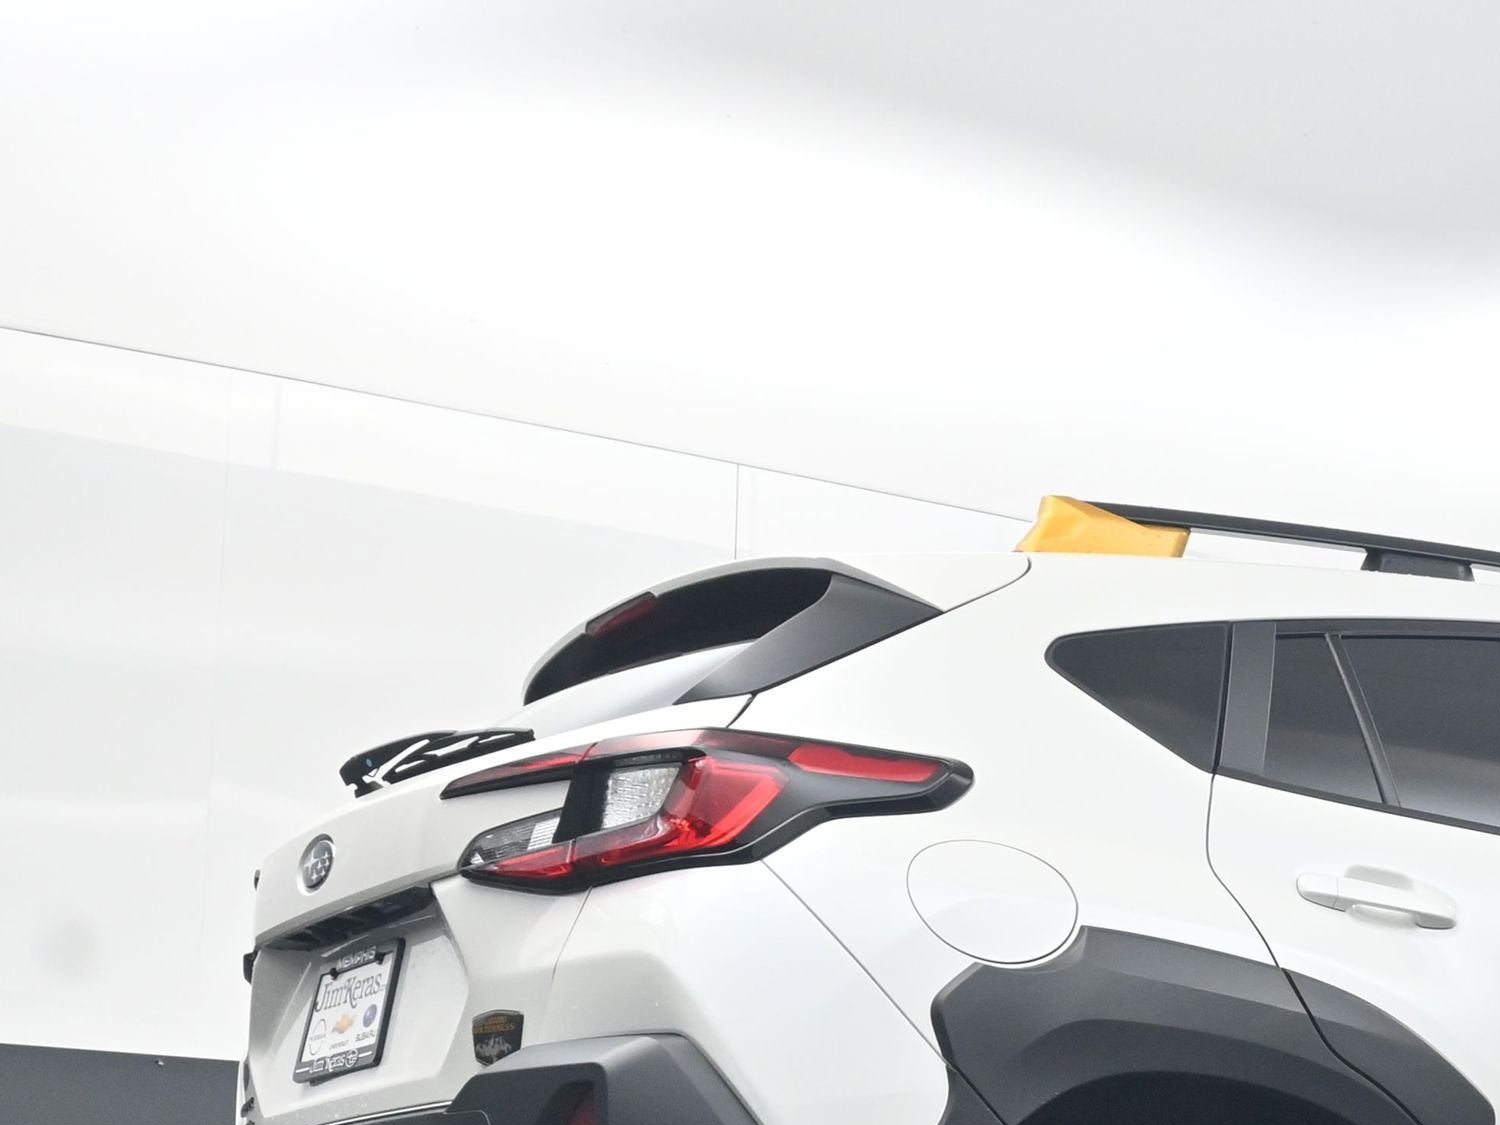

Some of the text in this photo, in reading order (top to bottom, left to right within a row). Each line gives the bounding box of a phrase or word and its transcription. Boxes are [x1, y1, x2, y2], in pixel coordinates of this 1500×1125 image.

[336, 946, 377, 969] MEMPHIS
[314, 973, 382, 1012] Jim Keras
